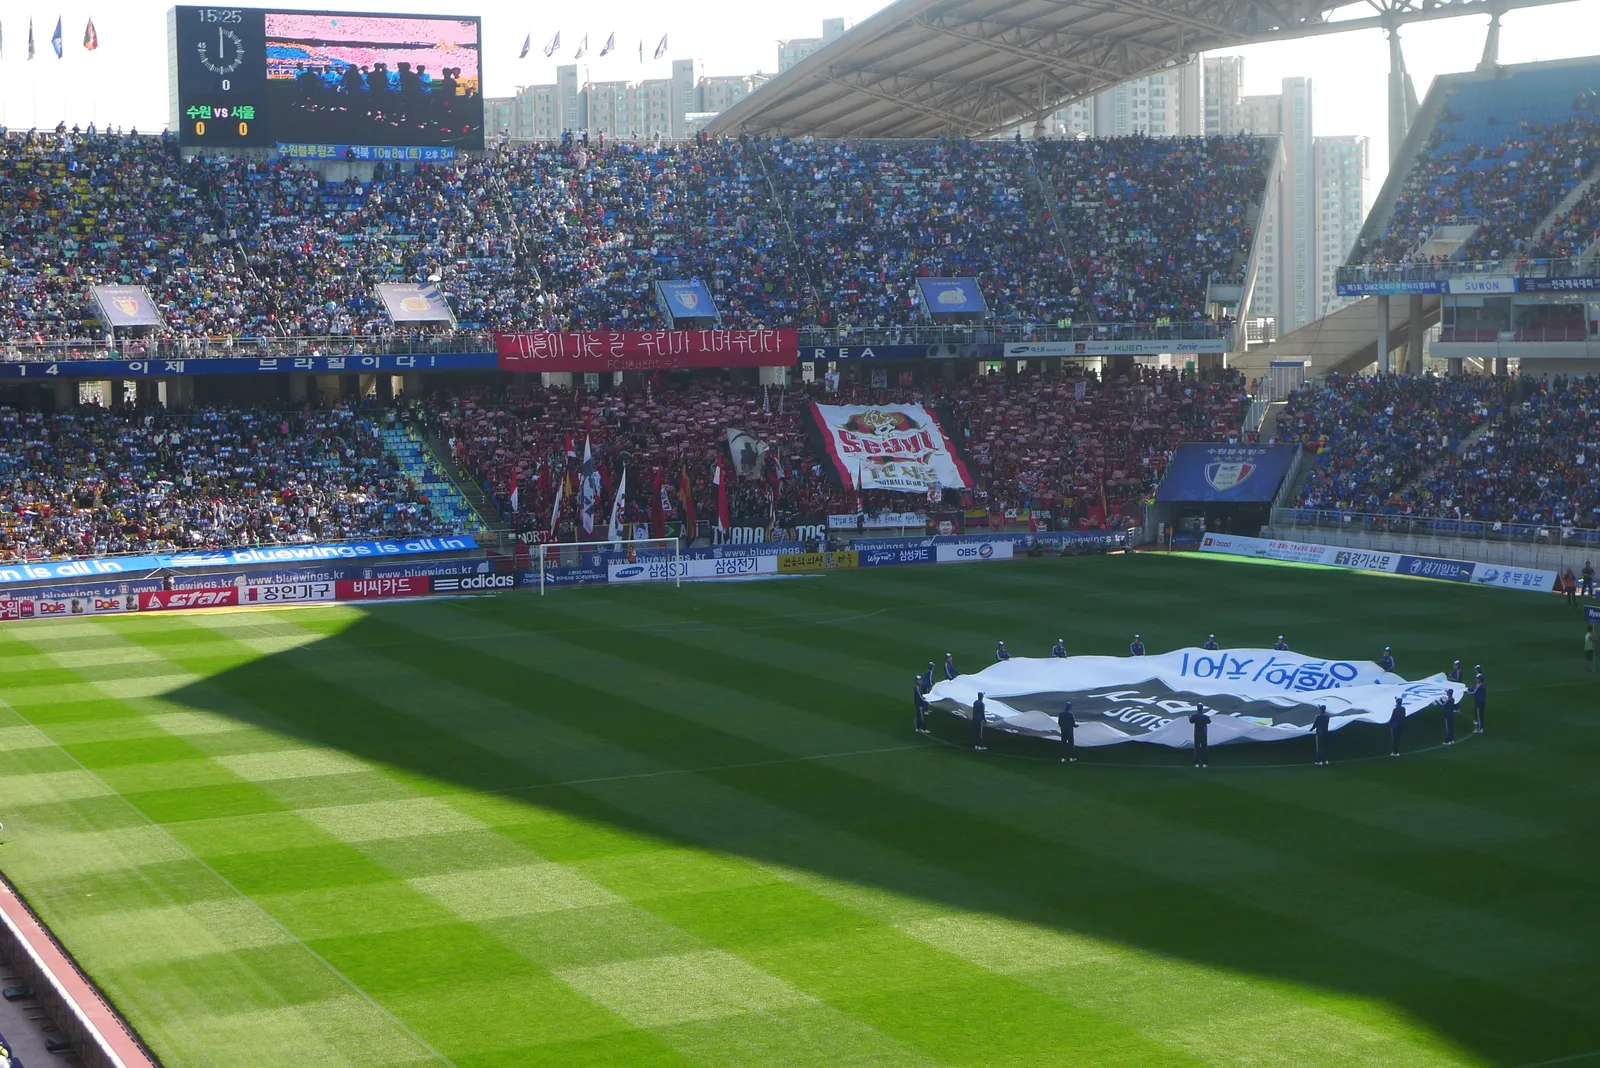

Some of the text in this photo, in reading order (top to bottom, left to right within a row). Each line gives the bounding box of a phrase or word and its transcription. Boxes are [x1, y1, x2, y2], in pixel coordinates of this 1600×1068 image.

[198, 9, 242, 23] 15:25
[222, 79, 231, 91] 0
[186, 105, 212, 119] 수원
[230, 105, 255, 119] 서울
[195, 121, 205, 135] 0
[238, 121, 248, 136] 0
[279, 144, 336, 158] 수원블루윙즈
[1465, 281, 1499, 291] SUWON
[1552, 279, 1594, 289] 전국체육대회
[501, 332, 564, 359] 그대들이
[570, 333, 603, 358] 가는
[609, 333, 625, 358] 길
[637, 332, 690, 357] 우리가
[234, 537, 465, 562] bluewings is all in
[900, 549, 929, 561] 삼성카드
[957, 548, 978, 557] OBS
[714, 557, 759, 574] 삼성전기
[1350, 551, 1390, 570] 경기신문
[23, 565, 52, 578] is
[56, 561, 92, 576] all
[92, 560, 123, 572] in
[1422, 561, 1460, 577] 경기일보
[248, 570, 344, 585] www.bluewings.kr
[461, 573, 514, 589] adidas
[1502, 570, 1544, 587] 중부일보
[264, 583, 331, 600] 장인가구
[353, 579, 411, 595] 비씨카드
[40, 602, 66, 614] Dole
[95, 597, 120, 609] Dole
